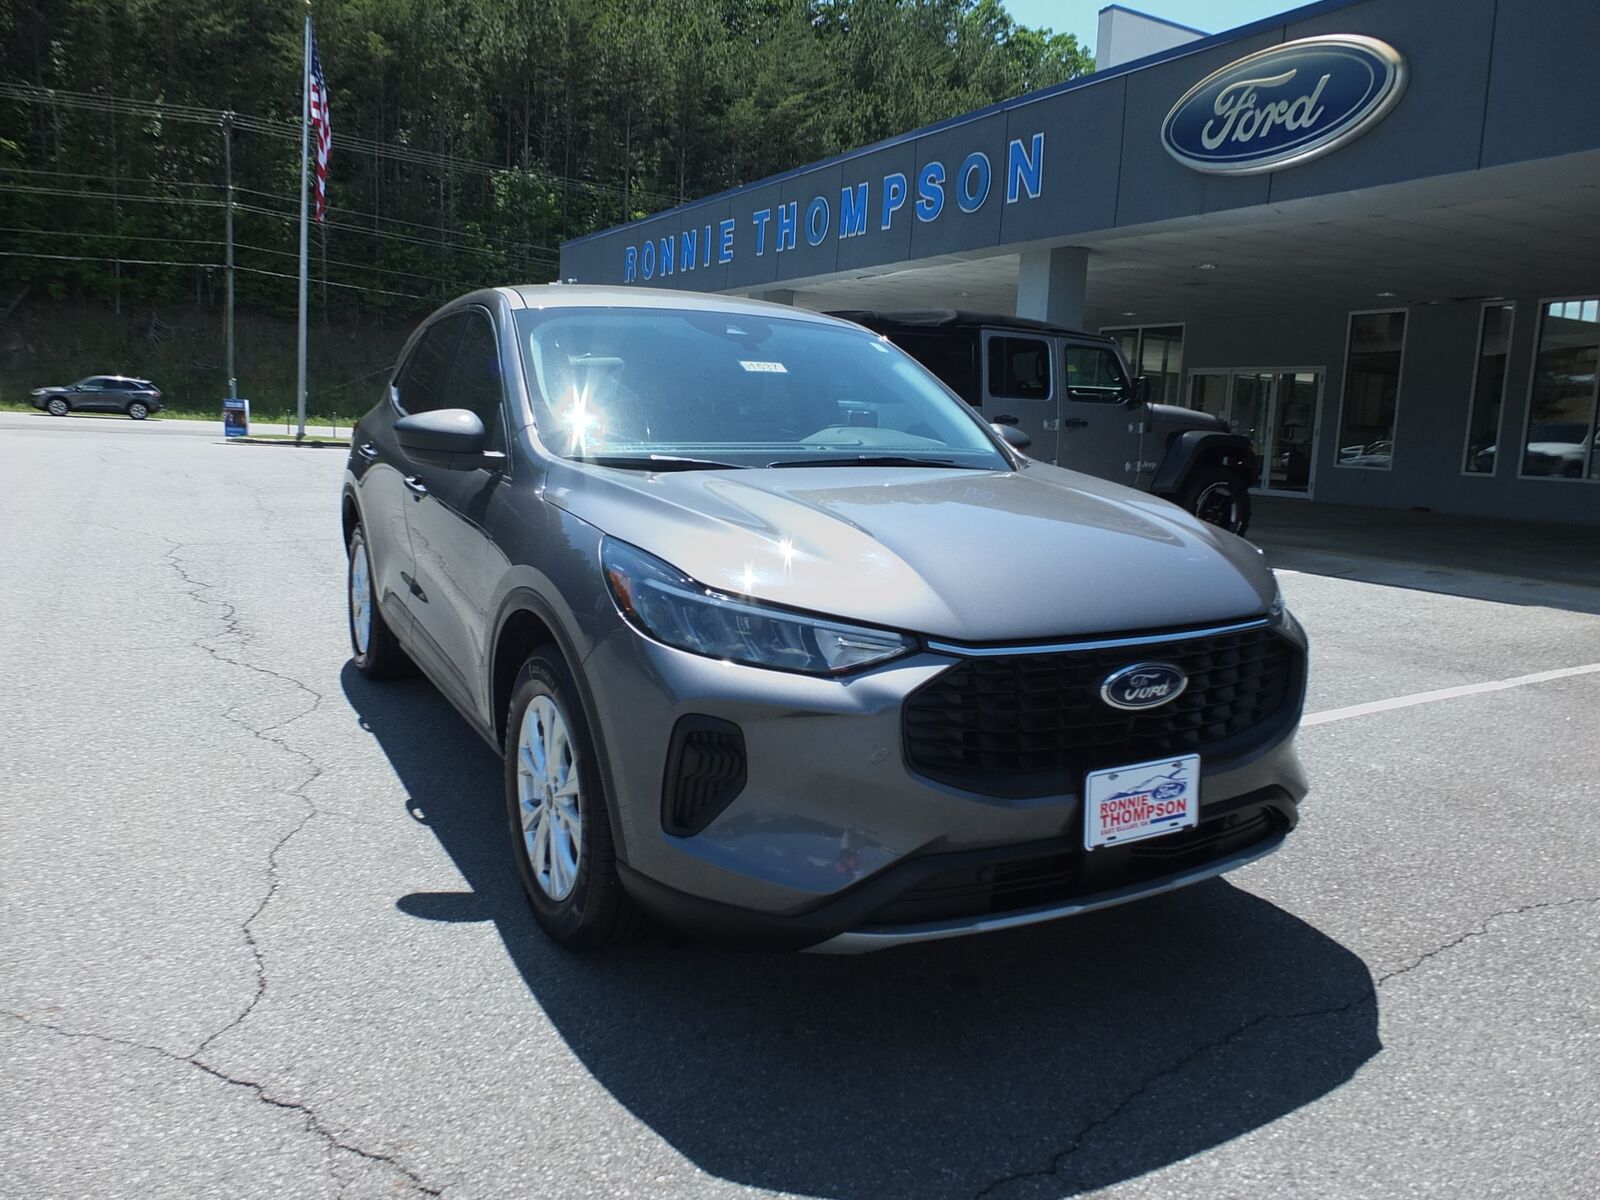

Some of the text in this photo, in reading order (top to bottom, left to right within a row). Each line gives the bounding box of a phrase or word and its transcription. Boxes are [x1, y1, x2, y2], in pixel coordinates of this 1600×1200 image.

[1201, 68, 1331, 150] Ford
[624, 132, 1045, 284] RONNIE THOMPSON
[1124, 673, 1170, 701] Ford
[1100, 795, 1149, 814] RONNIE
[1100, 799, 1187, 828] THOMPSON
